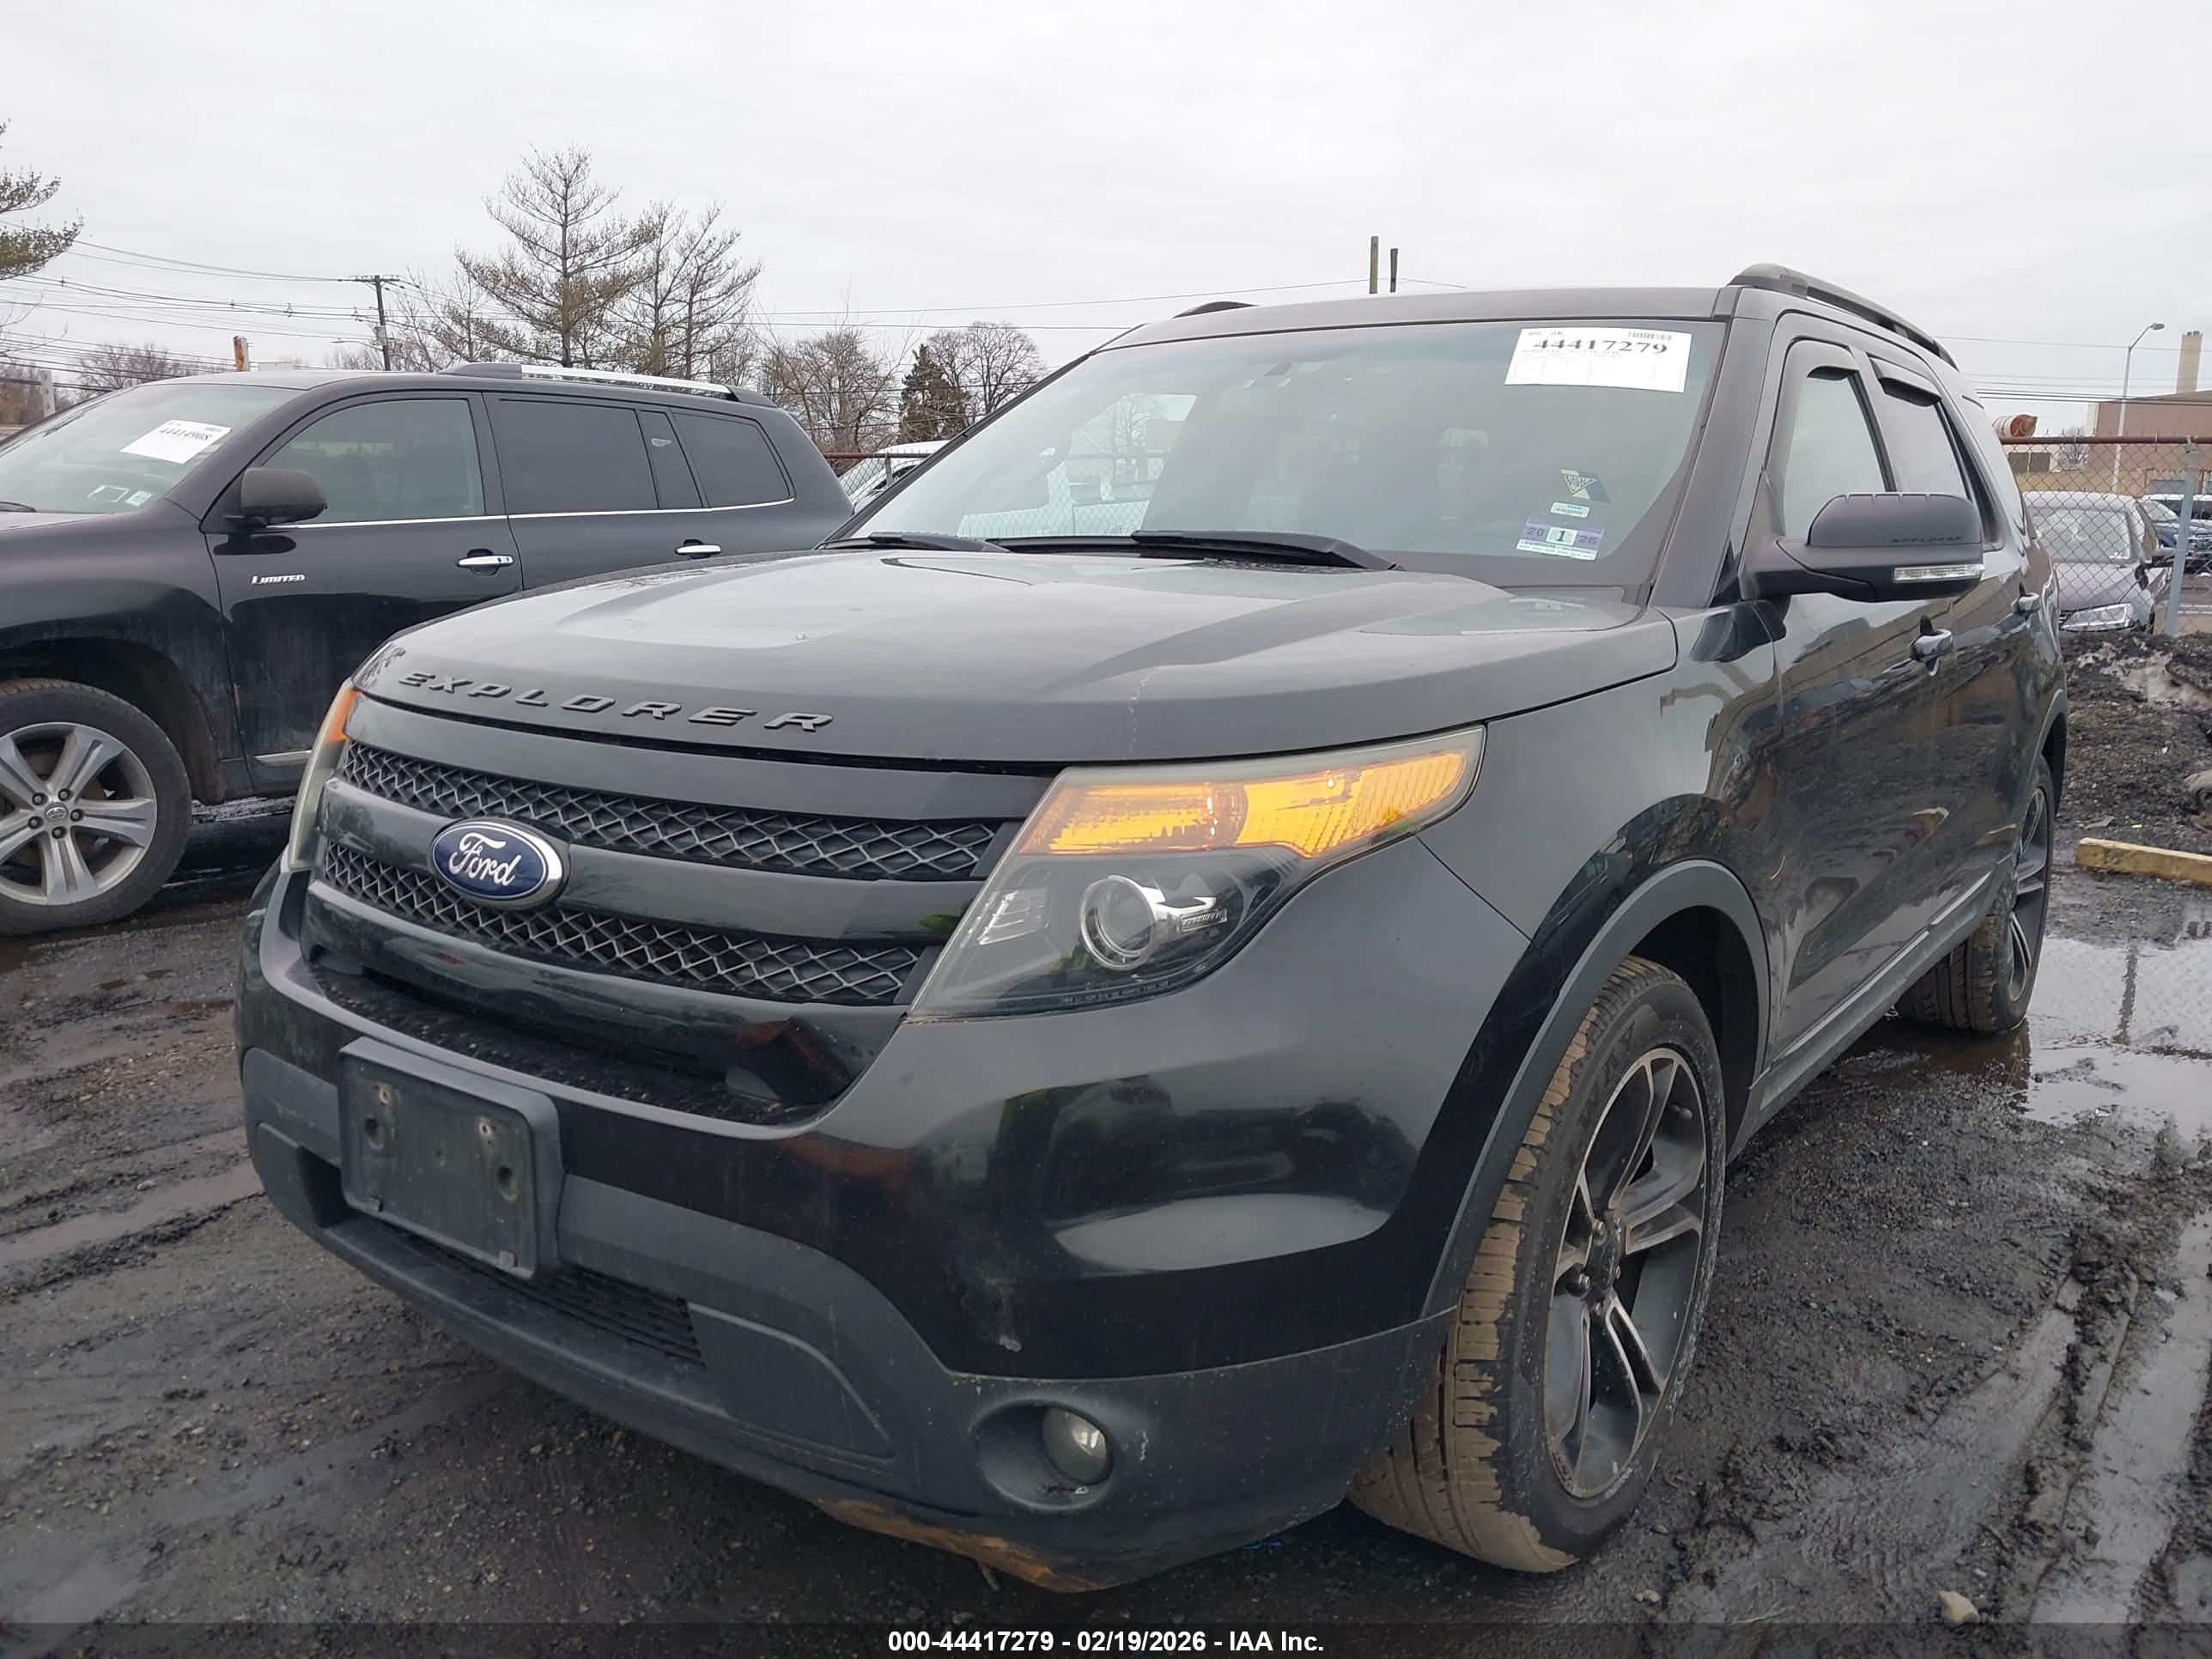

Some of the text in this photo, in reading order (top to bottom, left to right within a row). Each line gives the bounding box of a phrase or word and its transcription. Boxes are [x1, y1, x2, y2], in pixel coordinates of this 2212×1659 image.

[1534, 338, 1668, 355] 44417279
[1526, 527, 1597, 545] 20 1 26
[252, 574, 306, 585] LIMITED
[398, 672, 833, 732] EXPLORER
[448, 832, 522, 886] Ford
